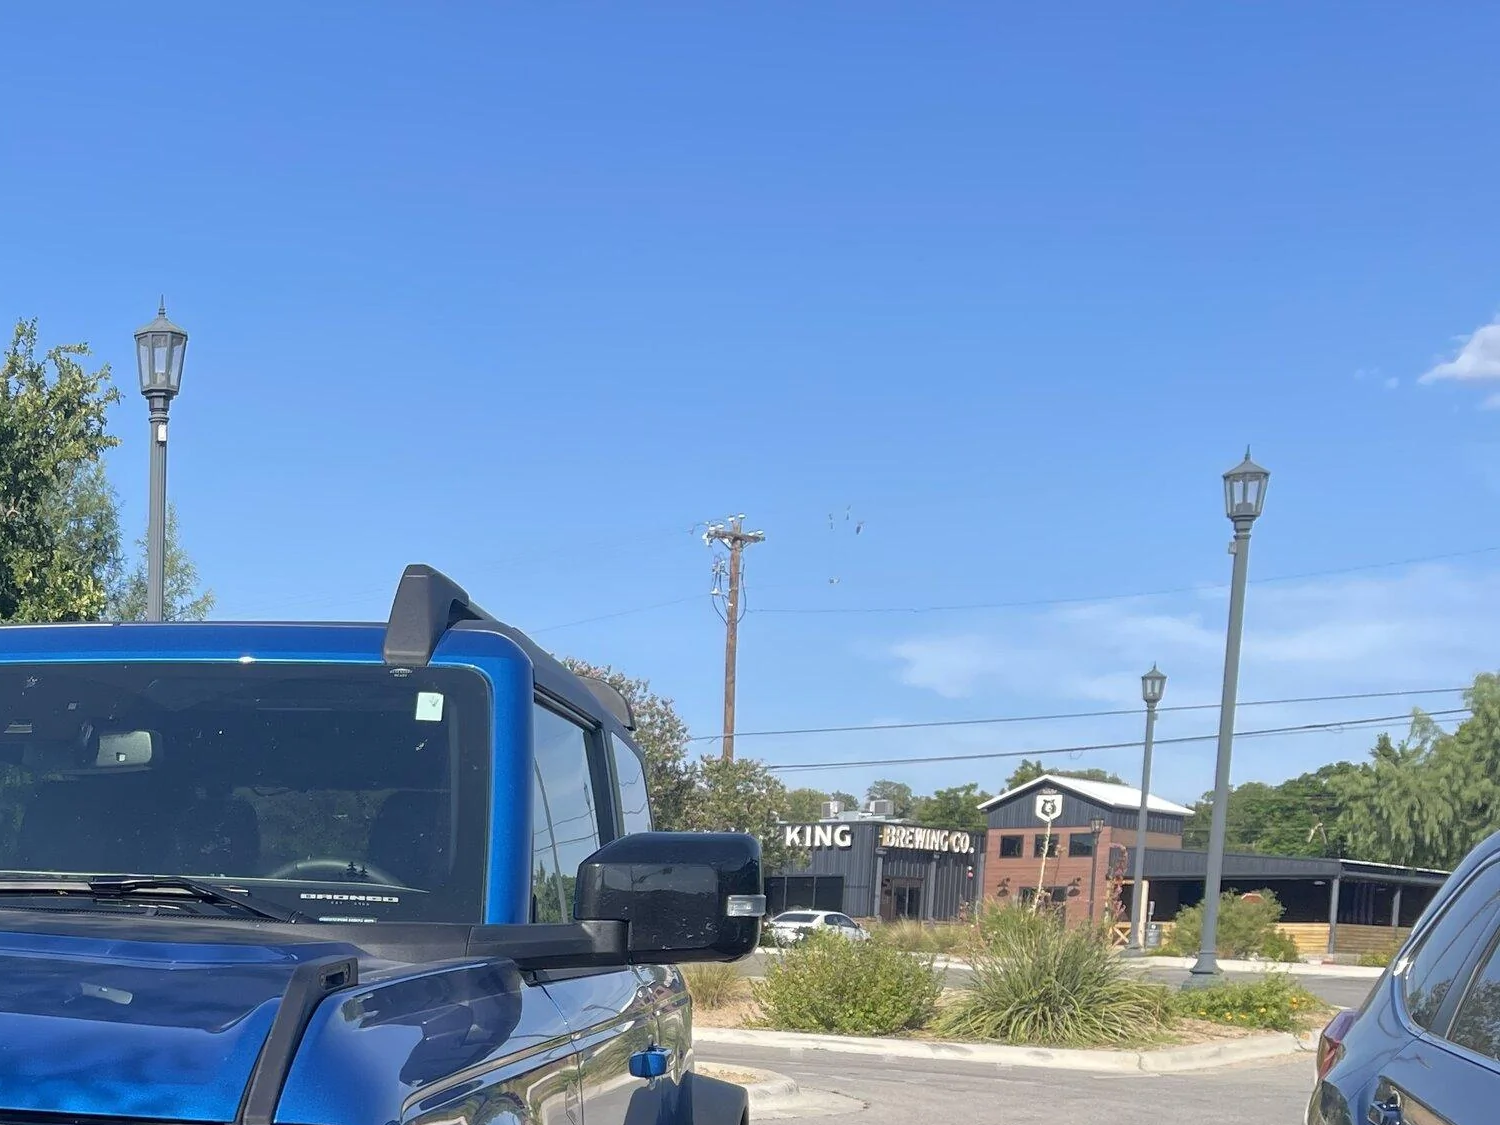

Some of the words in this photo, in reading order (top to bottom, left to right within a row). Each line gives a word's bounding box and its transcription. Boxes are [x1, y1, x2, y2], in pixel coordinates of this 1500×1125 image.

[785, 824, 852, 847] KING
[881, 825, 949, 852] BREWING
[949, 832, 975, 854] CO.
